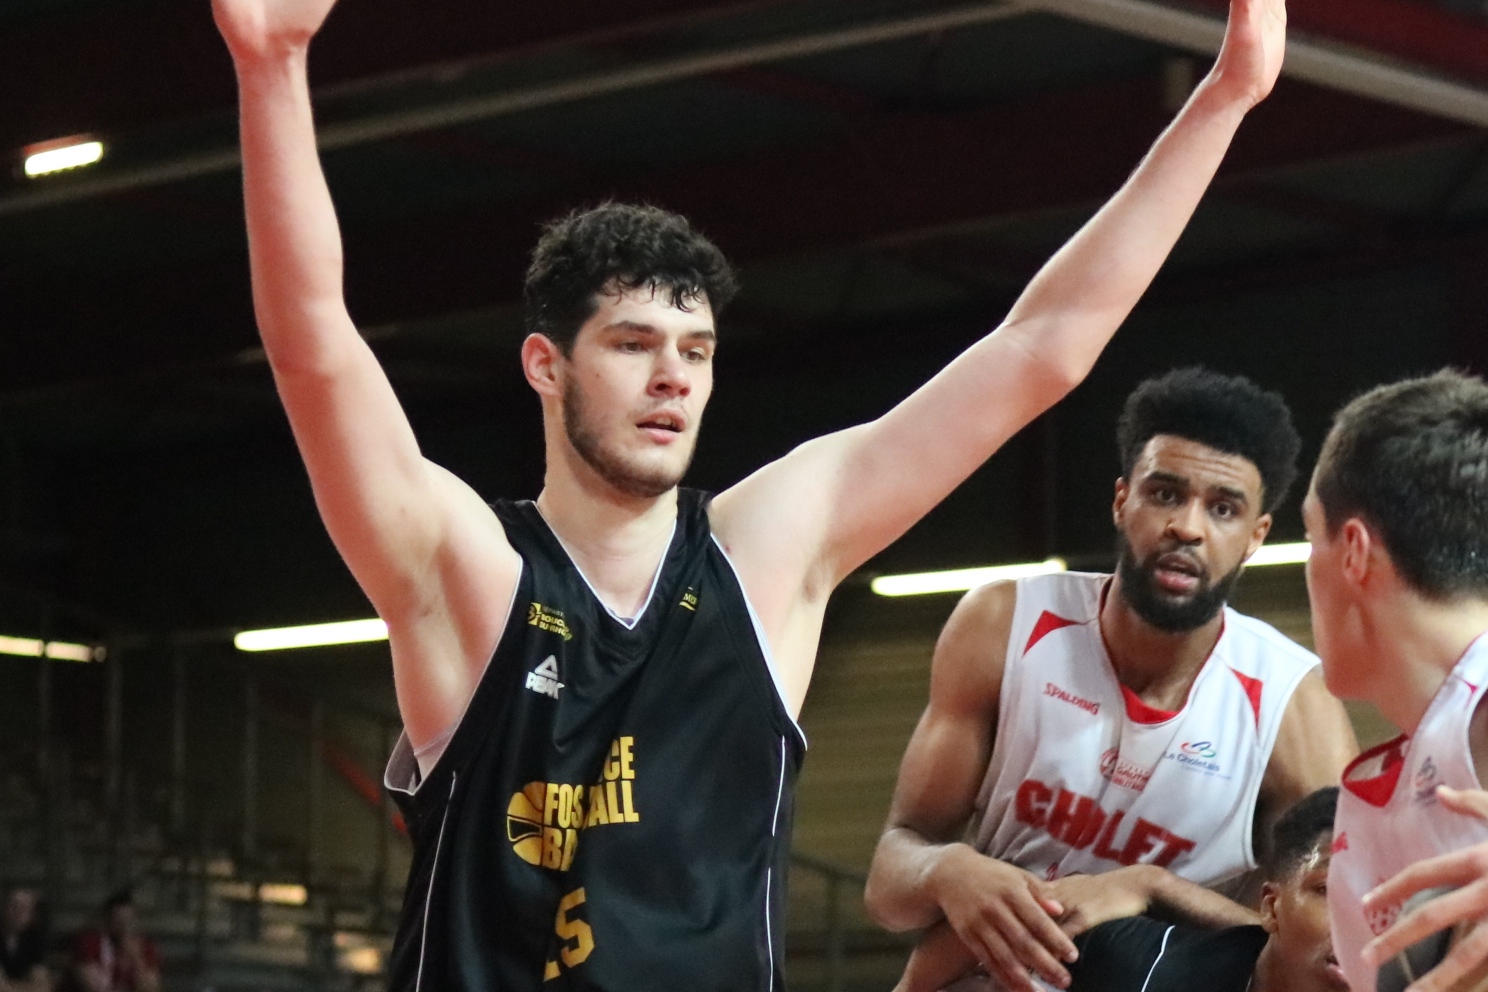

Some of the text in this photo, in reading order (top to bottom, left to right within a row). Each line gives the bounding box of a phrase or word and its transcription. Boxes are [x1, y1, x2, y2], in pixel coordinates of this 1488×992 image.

[525, 671, 566, 700] PEAK
[1042, 681, 1101, 717] SPALDING
[600, 736, 637, 780] CE
[543, 780, 640, 829] FOS ALL
